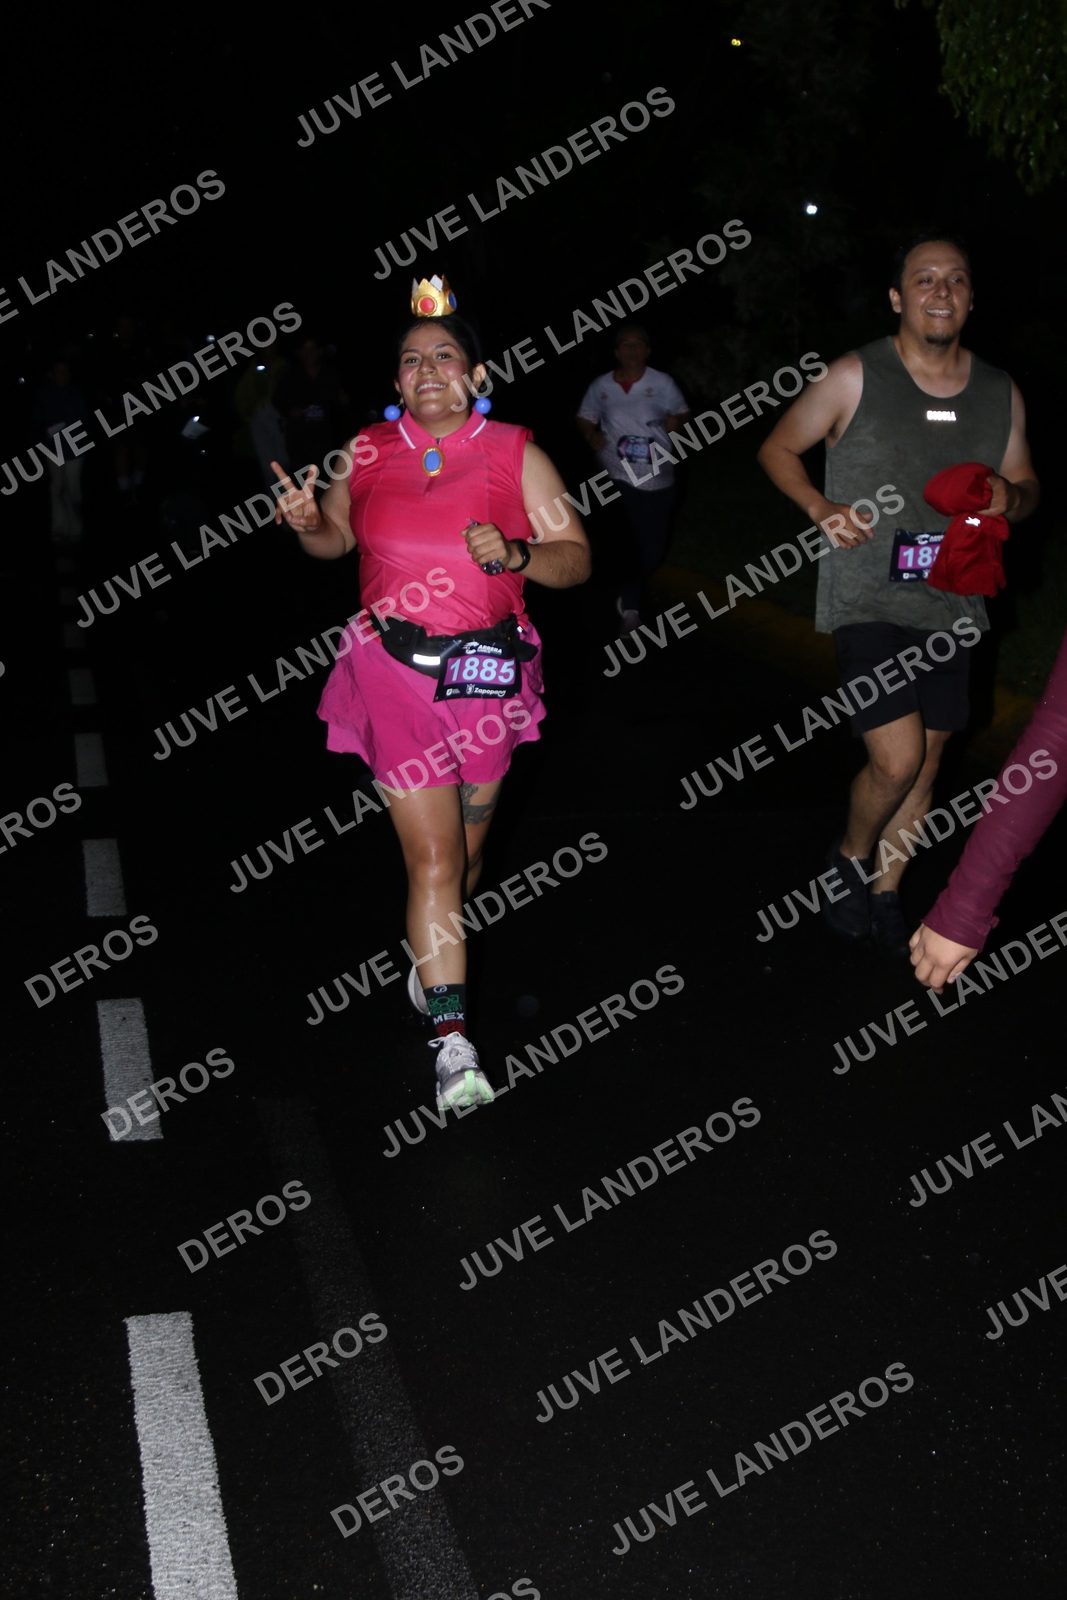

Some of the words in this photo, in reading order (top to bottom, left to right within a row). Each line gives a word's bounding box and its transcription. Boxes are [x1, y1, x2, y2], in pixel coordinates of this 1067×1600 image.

[903, 546, 940, 568] 18
[450, 656, 515, 684] 1885
[433, 1012, 465, 1025] MEX
